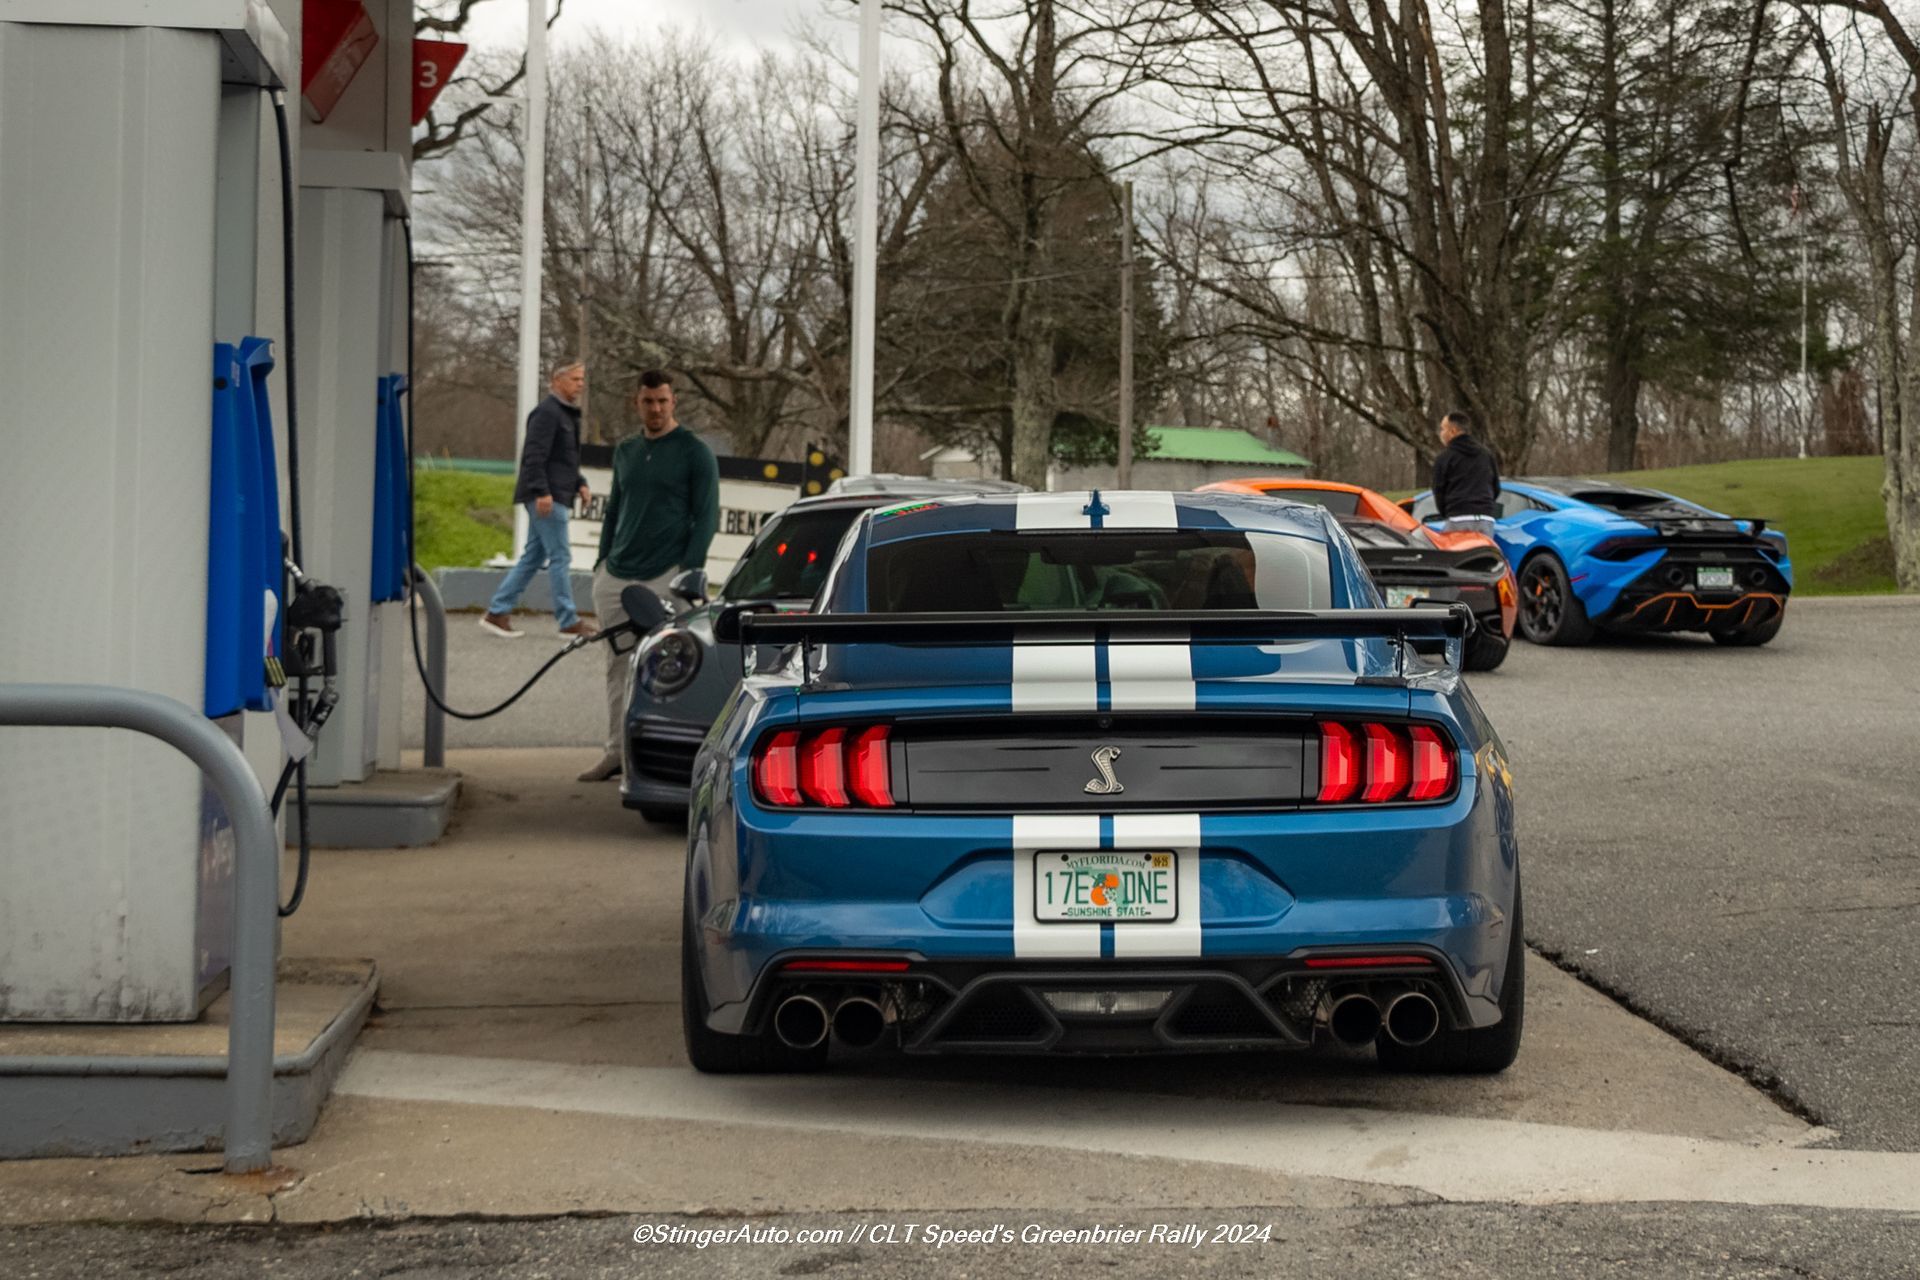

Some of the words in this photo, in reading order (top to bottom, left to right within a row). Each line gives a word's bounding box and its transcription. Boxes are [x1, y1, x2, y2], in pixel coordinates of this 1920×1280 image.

[418, 60, 438, 88] 3
[1045, 871, 1089, 904] 17E
[1067, 907, 1112, 918] SUNSHINE
[1116, 906, 1146, 917] STATE
